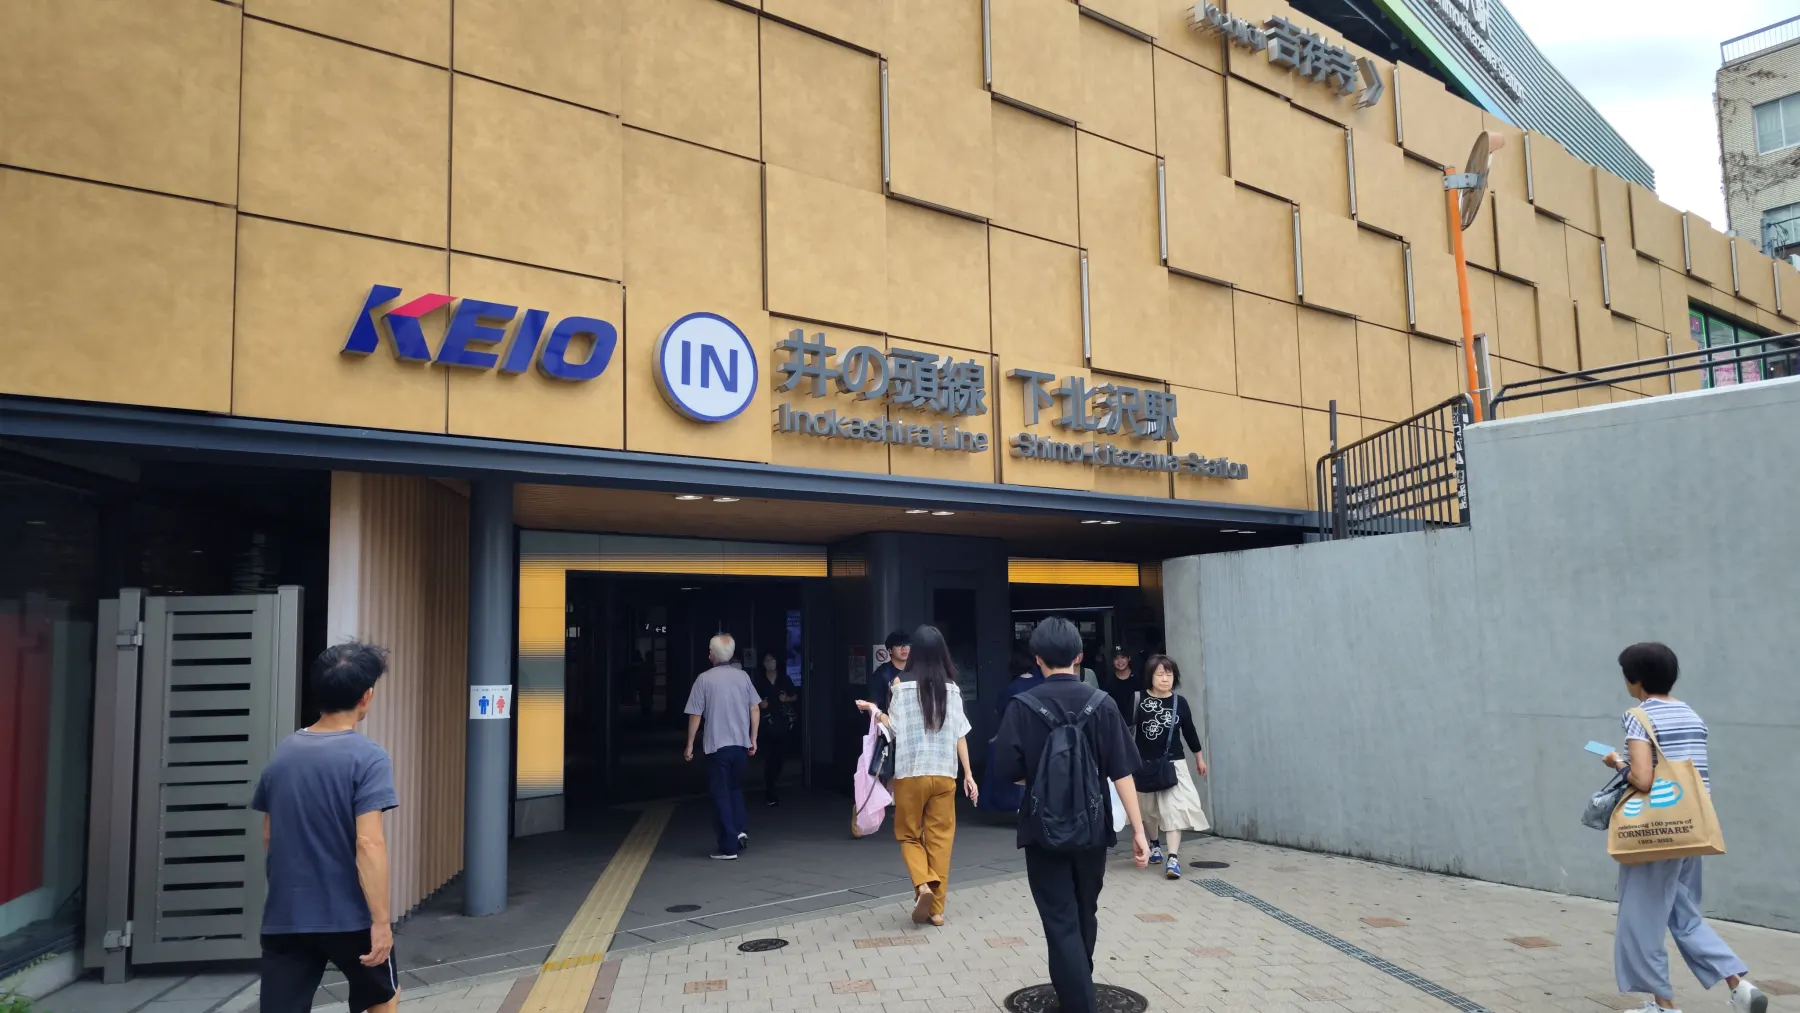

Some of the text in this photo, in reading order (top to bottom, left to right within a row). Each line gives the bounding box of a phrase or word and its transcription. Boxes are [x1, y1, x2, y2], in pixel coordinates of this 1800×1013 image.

[1263, 15, 1357, 95] 吉祥寺
[340, 284, 617, 381] KEIO
[681, 340, 739, 393] IN
[775, 329, 988, 417] 井の頭線
[778, 402, 989, 452] Inokashira Line
[1006, 368, 1180, 442] 下北沢駅
[1181, 452, 1249, 480] Station
[1664, 820, 1684, 828] years
